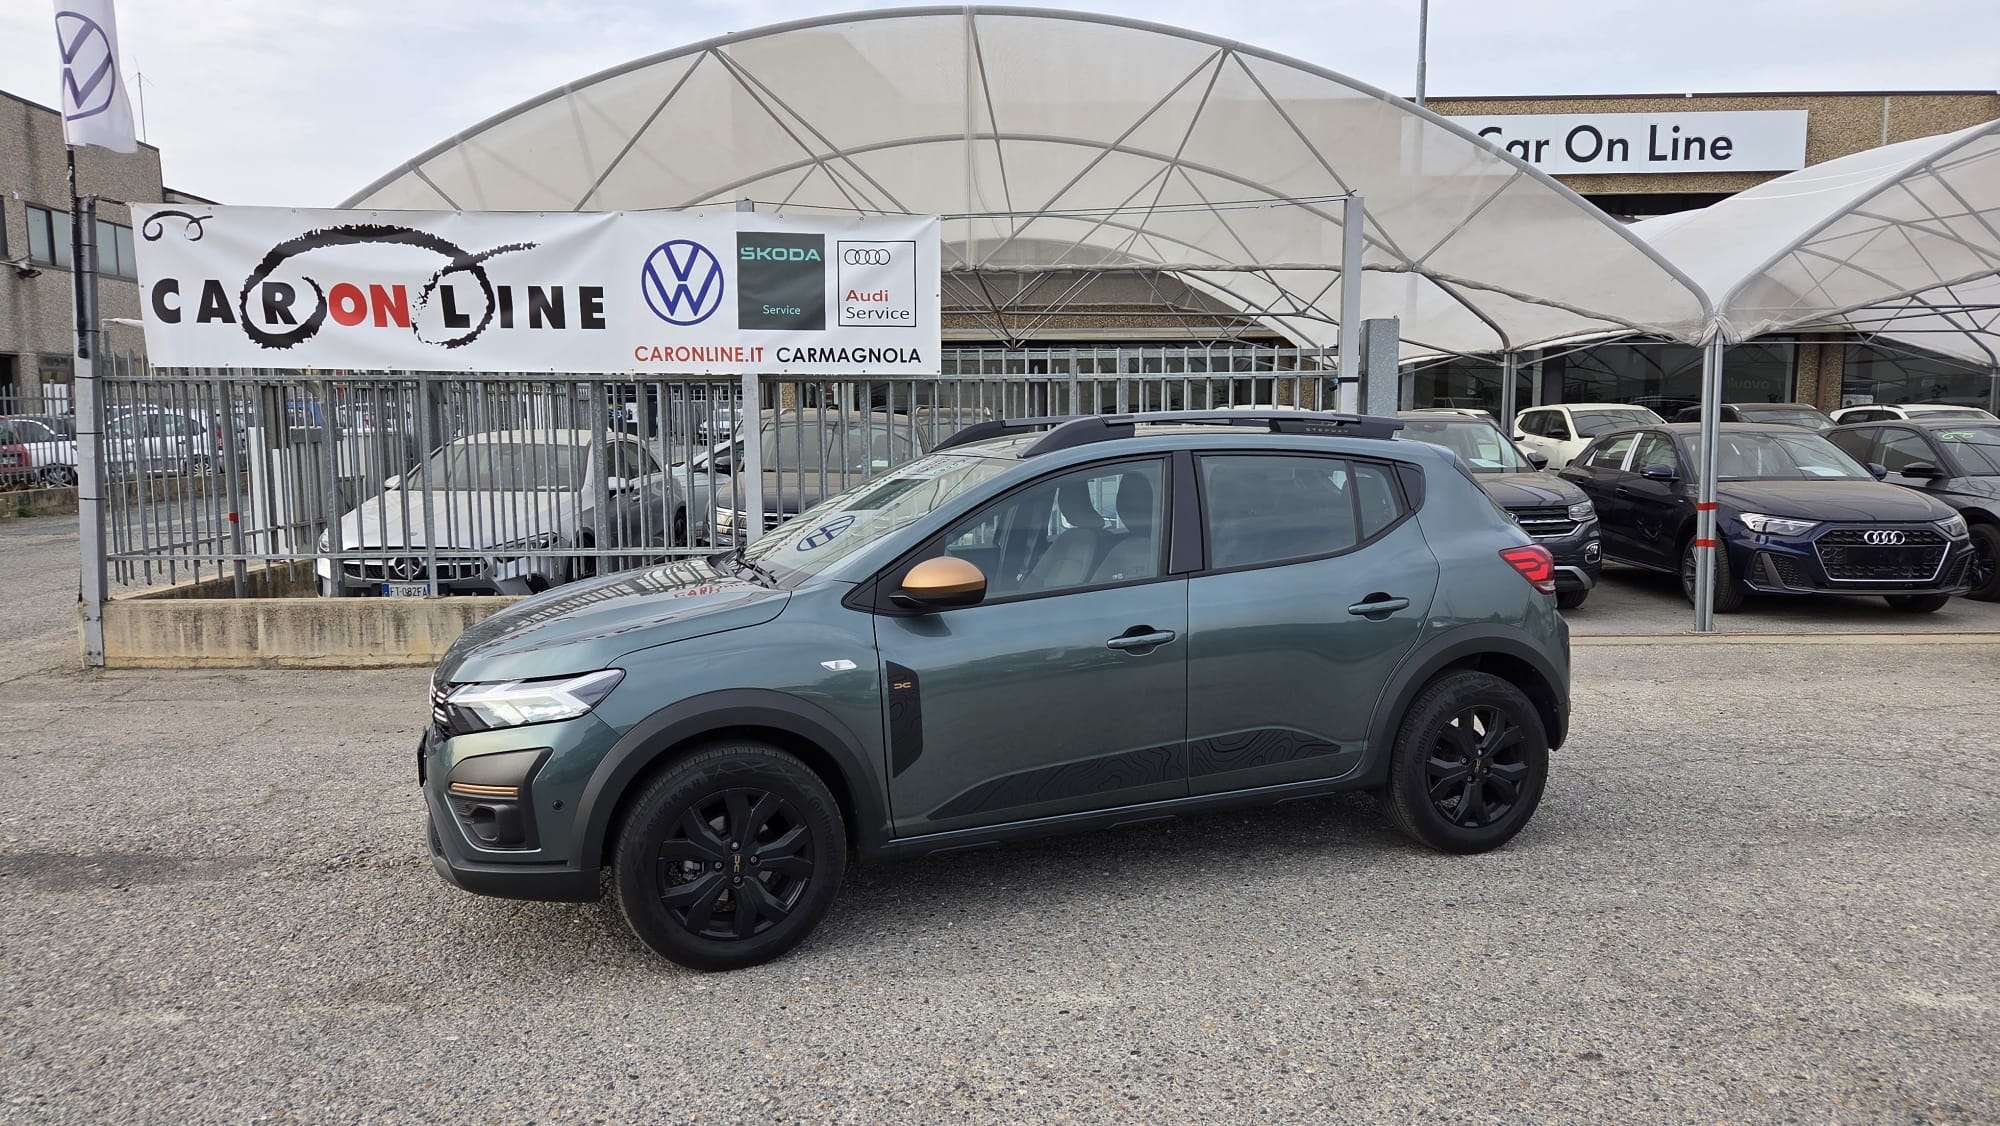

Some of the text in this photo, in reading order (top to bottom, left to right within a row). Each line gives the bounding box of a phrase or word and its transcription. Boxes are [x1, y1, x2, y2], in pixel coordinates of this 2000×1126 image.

[1565, 124, 1629, 163] On
[1648, 124, 1733, 162] Line
[845, 289, 889, 302] Audi
[762, 304, 801, 317] Service
[845, 306, 911, 320] Service
[634, 345, 922, 364] CARONLINE.IT CARMAGNOLA
